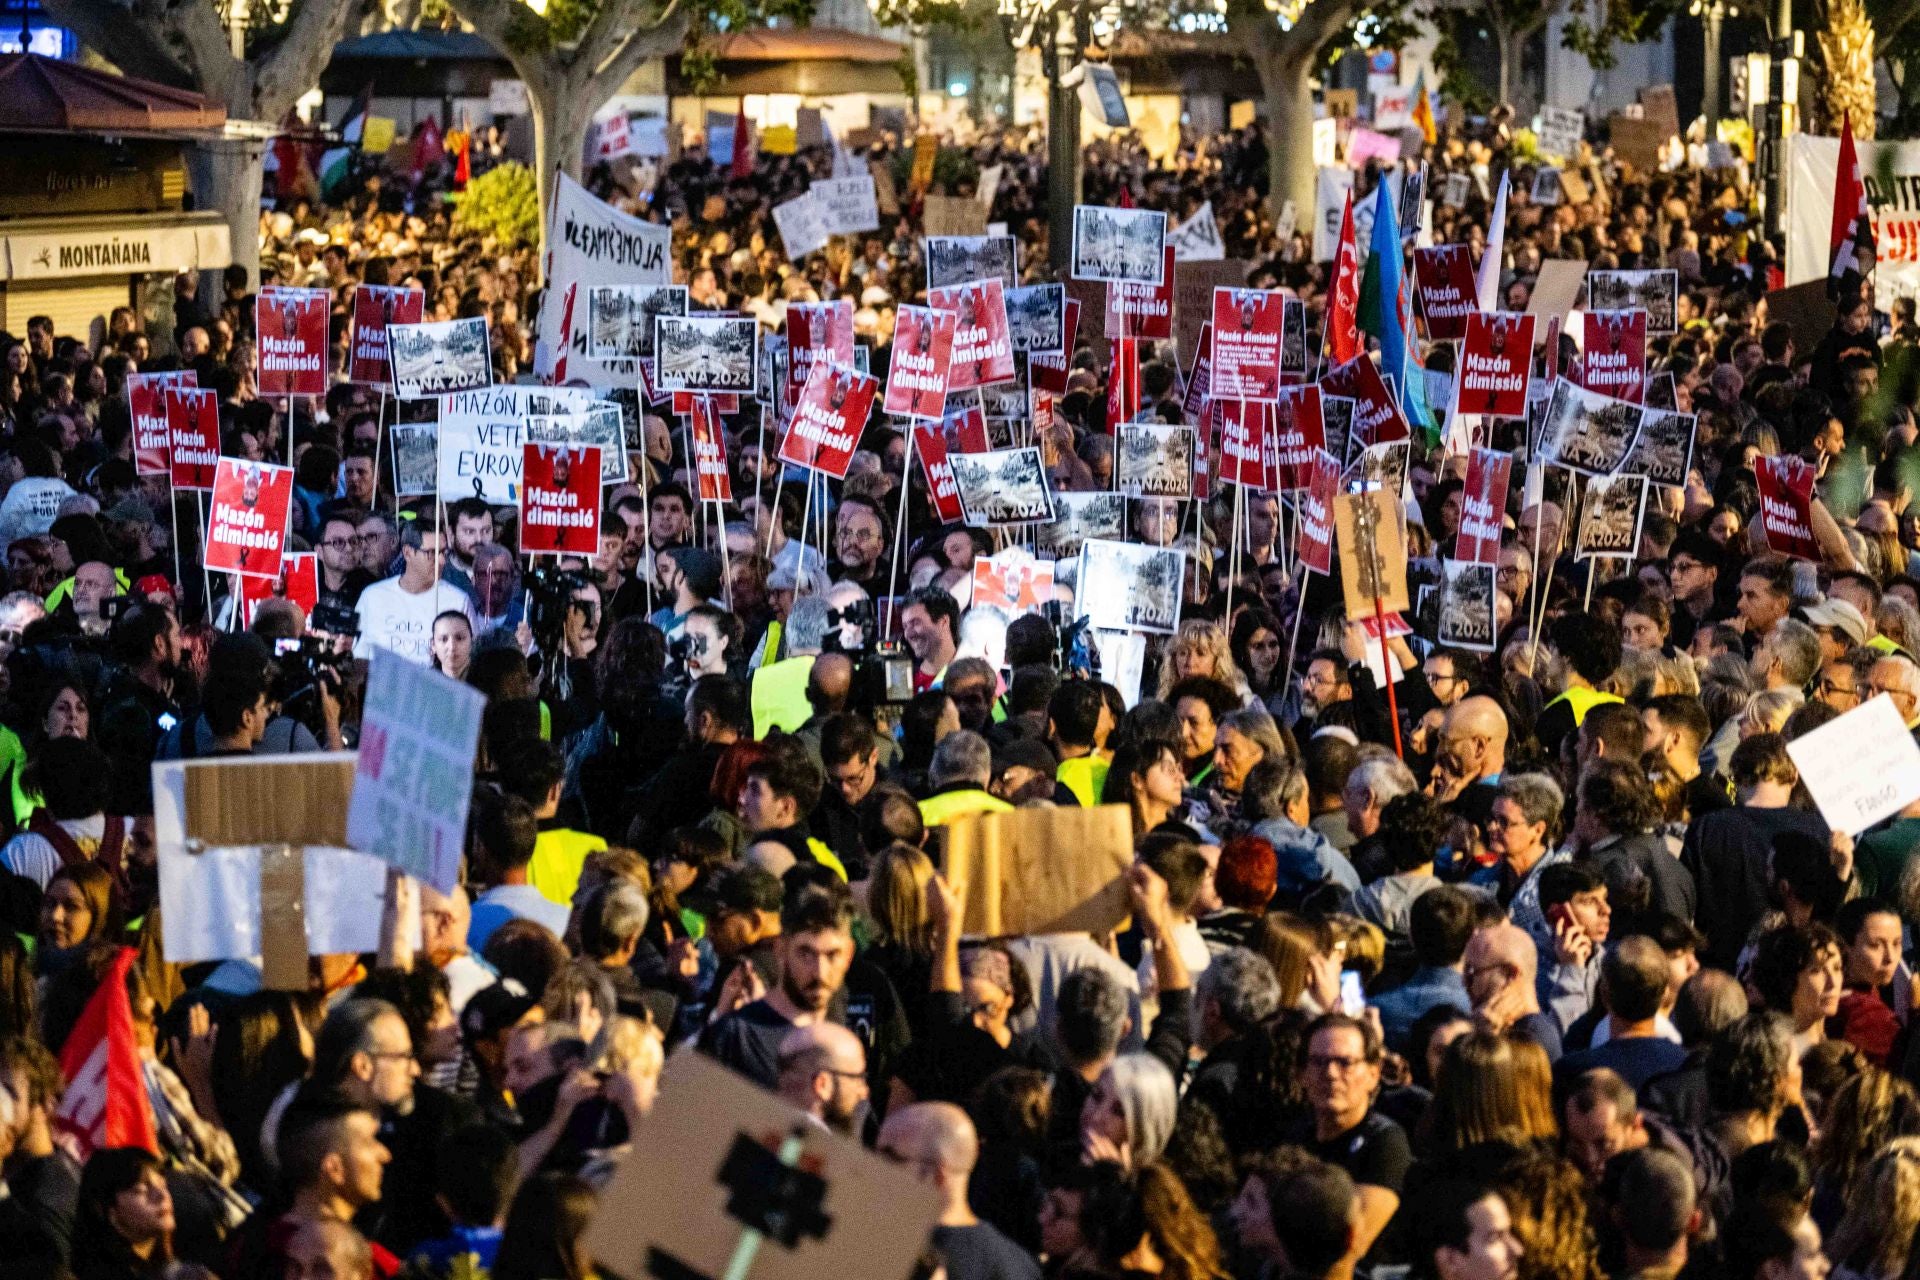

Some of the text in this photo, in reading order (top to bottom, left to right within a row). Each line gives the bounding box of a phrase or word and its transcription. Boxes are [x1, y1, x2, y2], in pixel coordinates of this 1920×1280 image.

[60, 236, 150, 269] MONTAÑANA
[1126, 261, 1159, 276] 2024
[1424, 284, 1460, 301] Mazón
[1647, 315, 1672, 329] 024
[358, 325, 387, 342] Maz
[953, 325, 988, 346] azón
[1024, 334, 1059, 348] 2024
[1217, 329, 1278, 344] Mazón dimissió
[263, 335, 305, 353] Mazón
[357, 343, 388, 360] dimi
[263, 353, 320, 371] dimissió
[896, 350, 936, 372] Mazón
[1467, 353, 1511, 372] Mazón
[1587, 350, 1628, 368] Mazón
[449, 371, 487, 389] 2024
[712, 371, 751, 387] 2024
[893, 371, 944, 393] dimissió
[1465, 372, 1523, 391] dimissió
[1587, 367, 1640, 385] dimissió
[800, 400, 847, 431] Mazón
[140, 431, 170, 449] dimi
[172, 428, 206, 448] Mazón
[793, 419, 855, 453] dimissió
[992, 430, 1008, 443] 24
[174, 446, 219, 466] dimissió
[602, 461, 620, 476] 24
[1646, 463, 1681, 481] 2024
[1165, 479, 1188, 492] 2024
[527, 486, 578, 508] Mazón
[215, 503, 265, 529] Mazón
[1010, 501, 1047, 518] 2024
[1763, 494, 1797, 521] Mazón
[527, 507, 594, 528] dimissió
[1766, 513, 1812, 541] dimissió
[213, 522, 279, 551] dimissió
[1596, 534, 1632, 547] 2024
[1455, 623, 1491, 640] 2024
